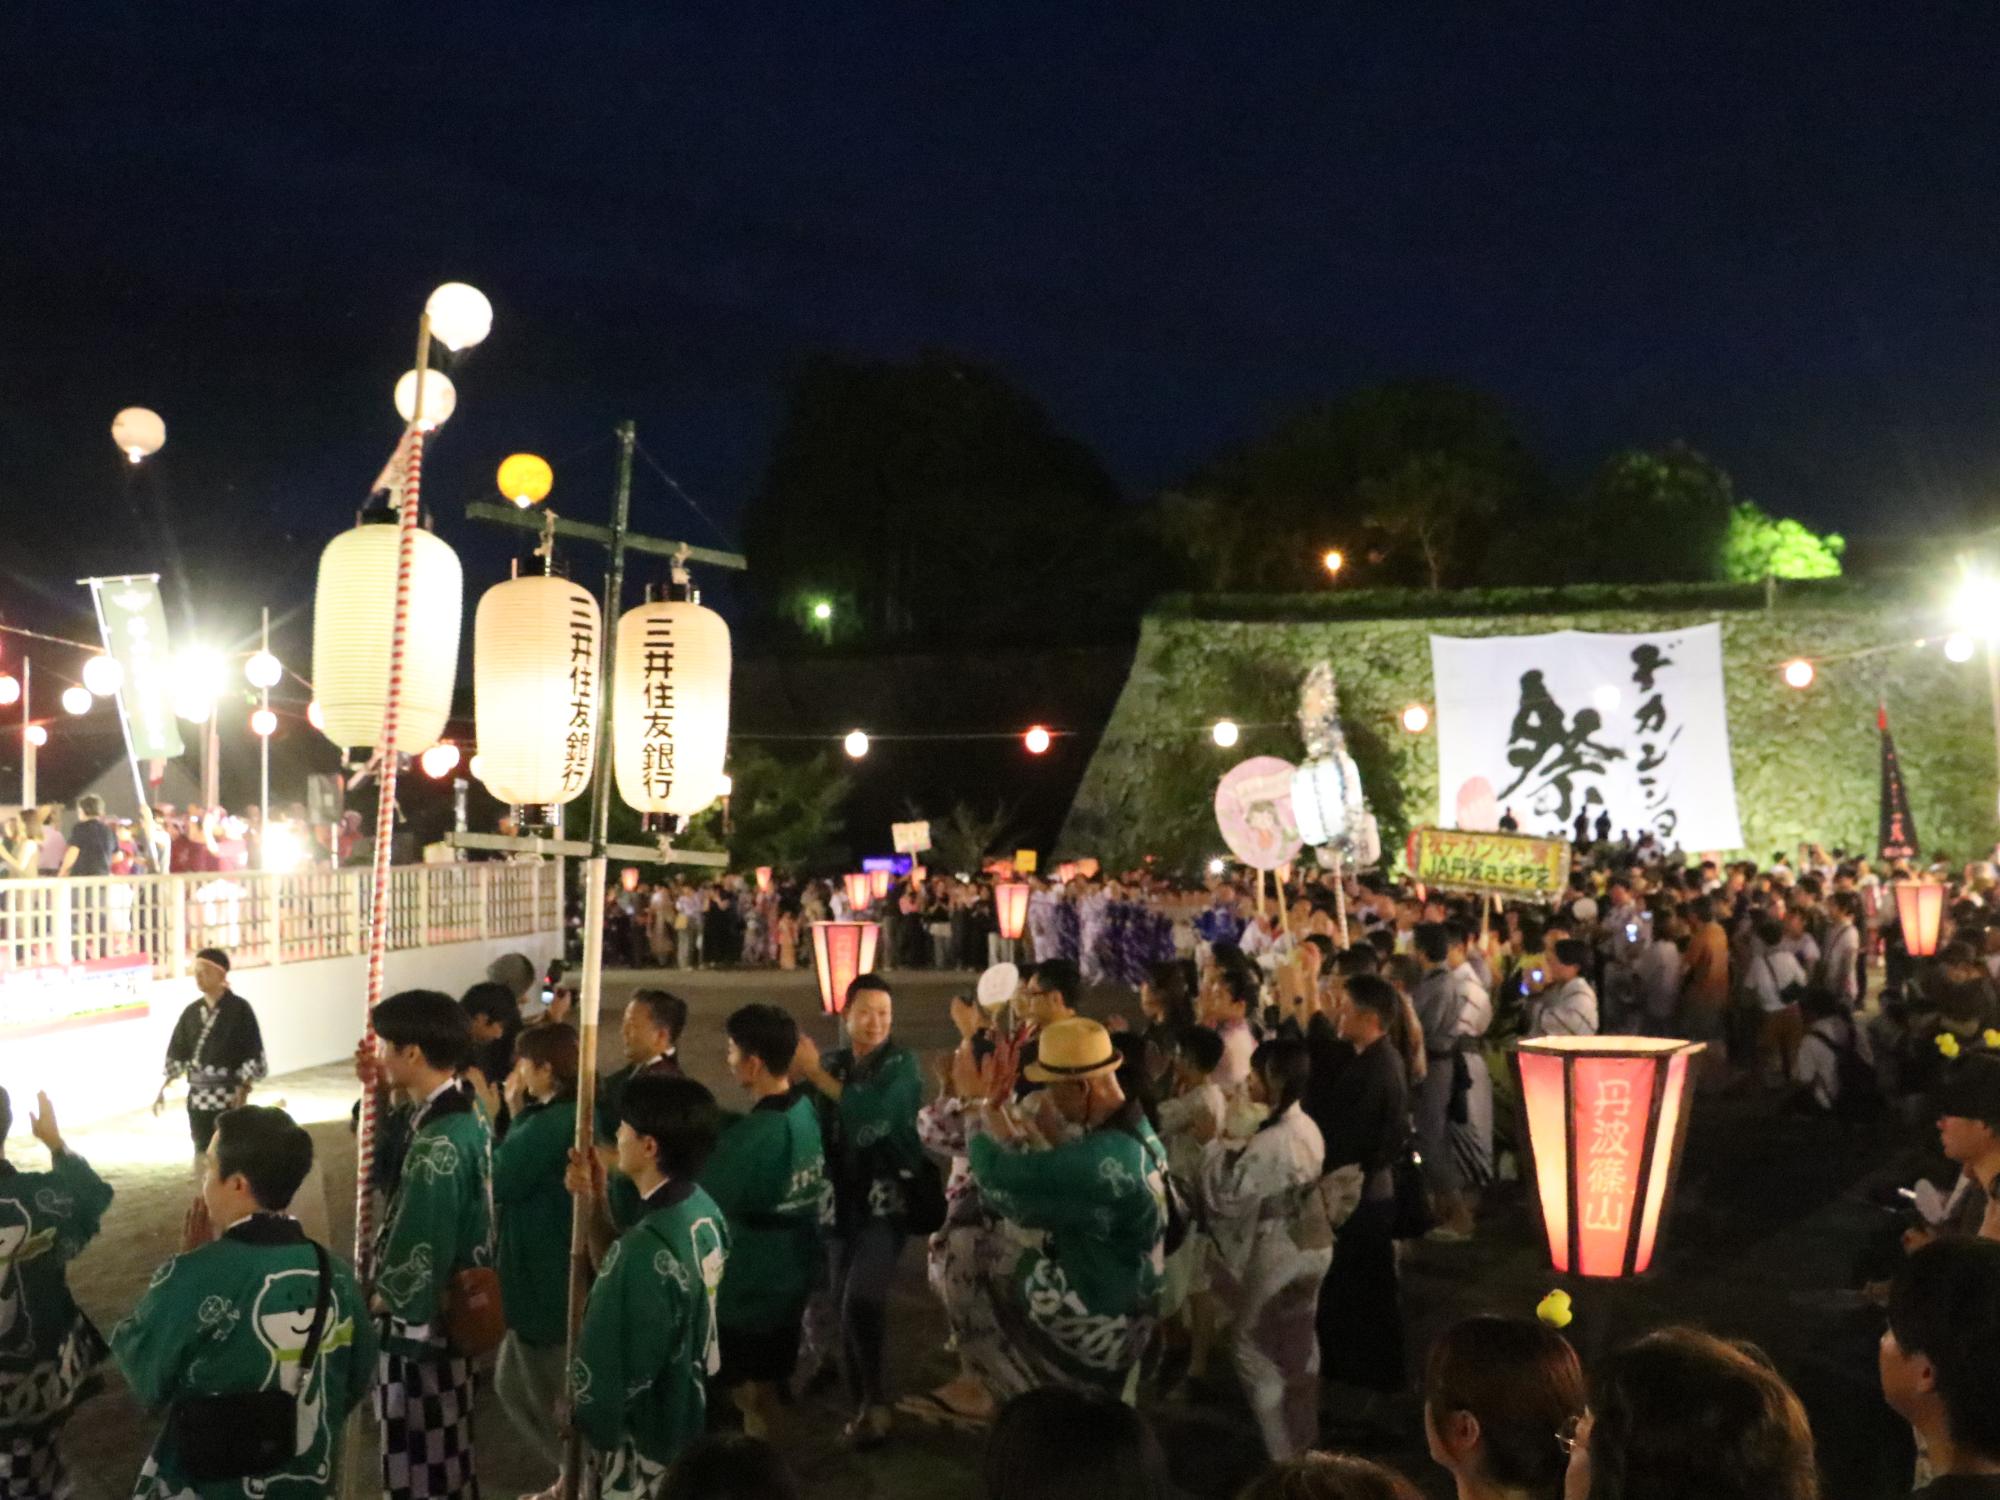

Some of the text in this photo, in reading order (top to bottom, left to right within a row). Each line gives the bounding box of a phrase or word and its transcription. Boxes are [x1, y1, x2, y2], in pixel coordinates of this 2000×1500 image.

[562, 596, 593, 792] 三井住友銀行
[643, 618, 675, 799] 三井住友銀行
[1496, 669, 1628, 823] 祭
[1585, 1079, 1631, 1231] 丹波篠山
